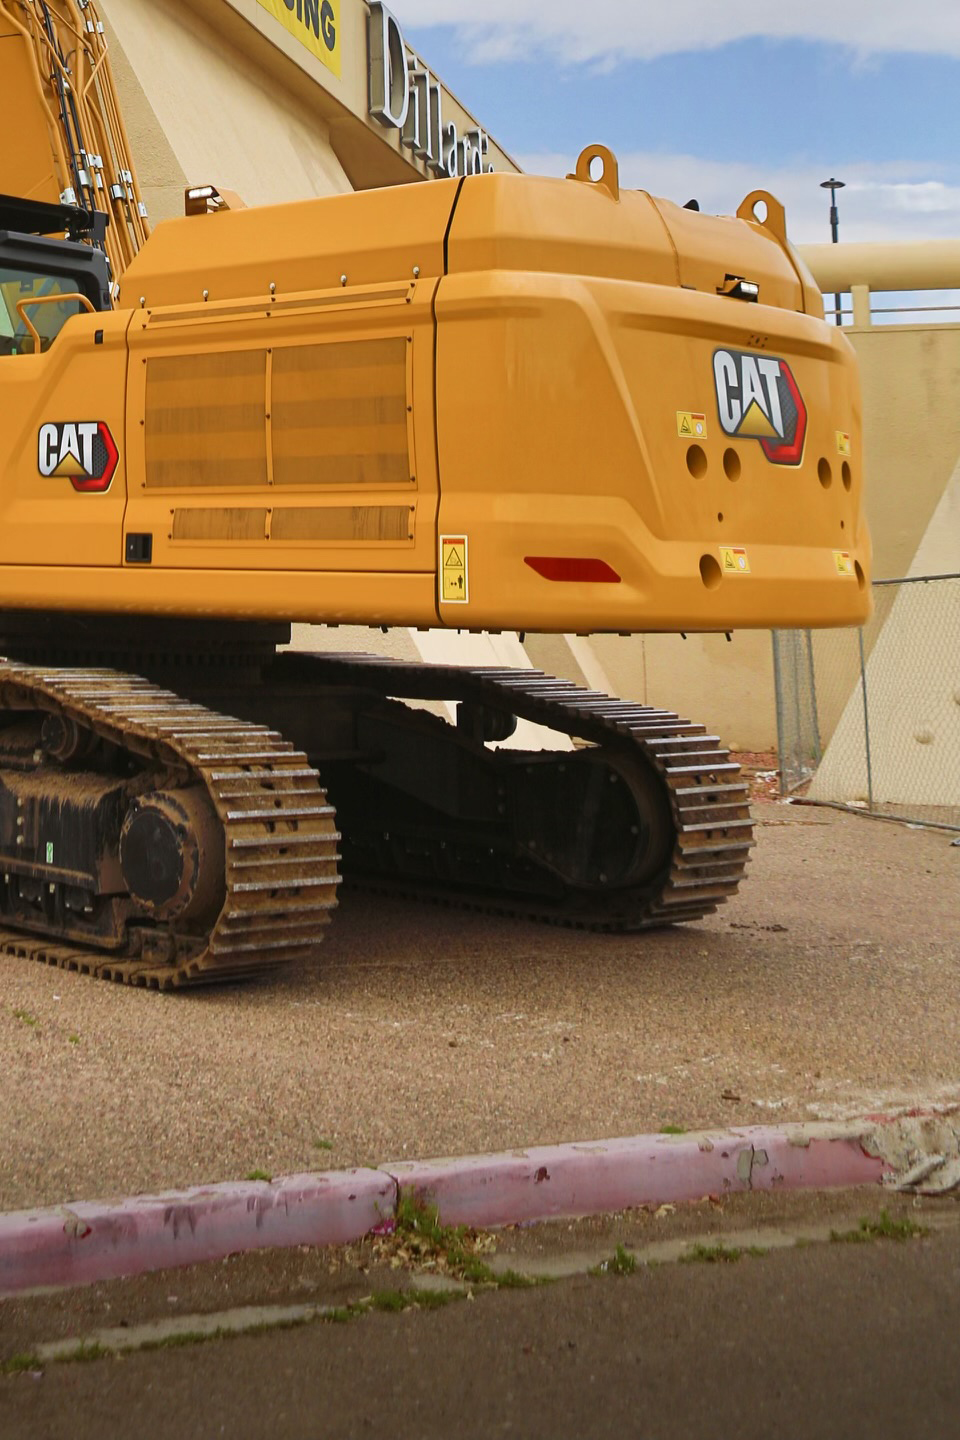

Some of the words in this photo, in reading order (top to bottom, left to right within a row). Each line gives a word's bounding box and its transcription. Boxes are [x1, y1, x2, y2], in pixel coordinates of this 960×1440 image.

[370, 1, 495, 177] Dillard'
[714, 350, 785, 439] CAT
[38, 422, 98, 476] CAT
